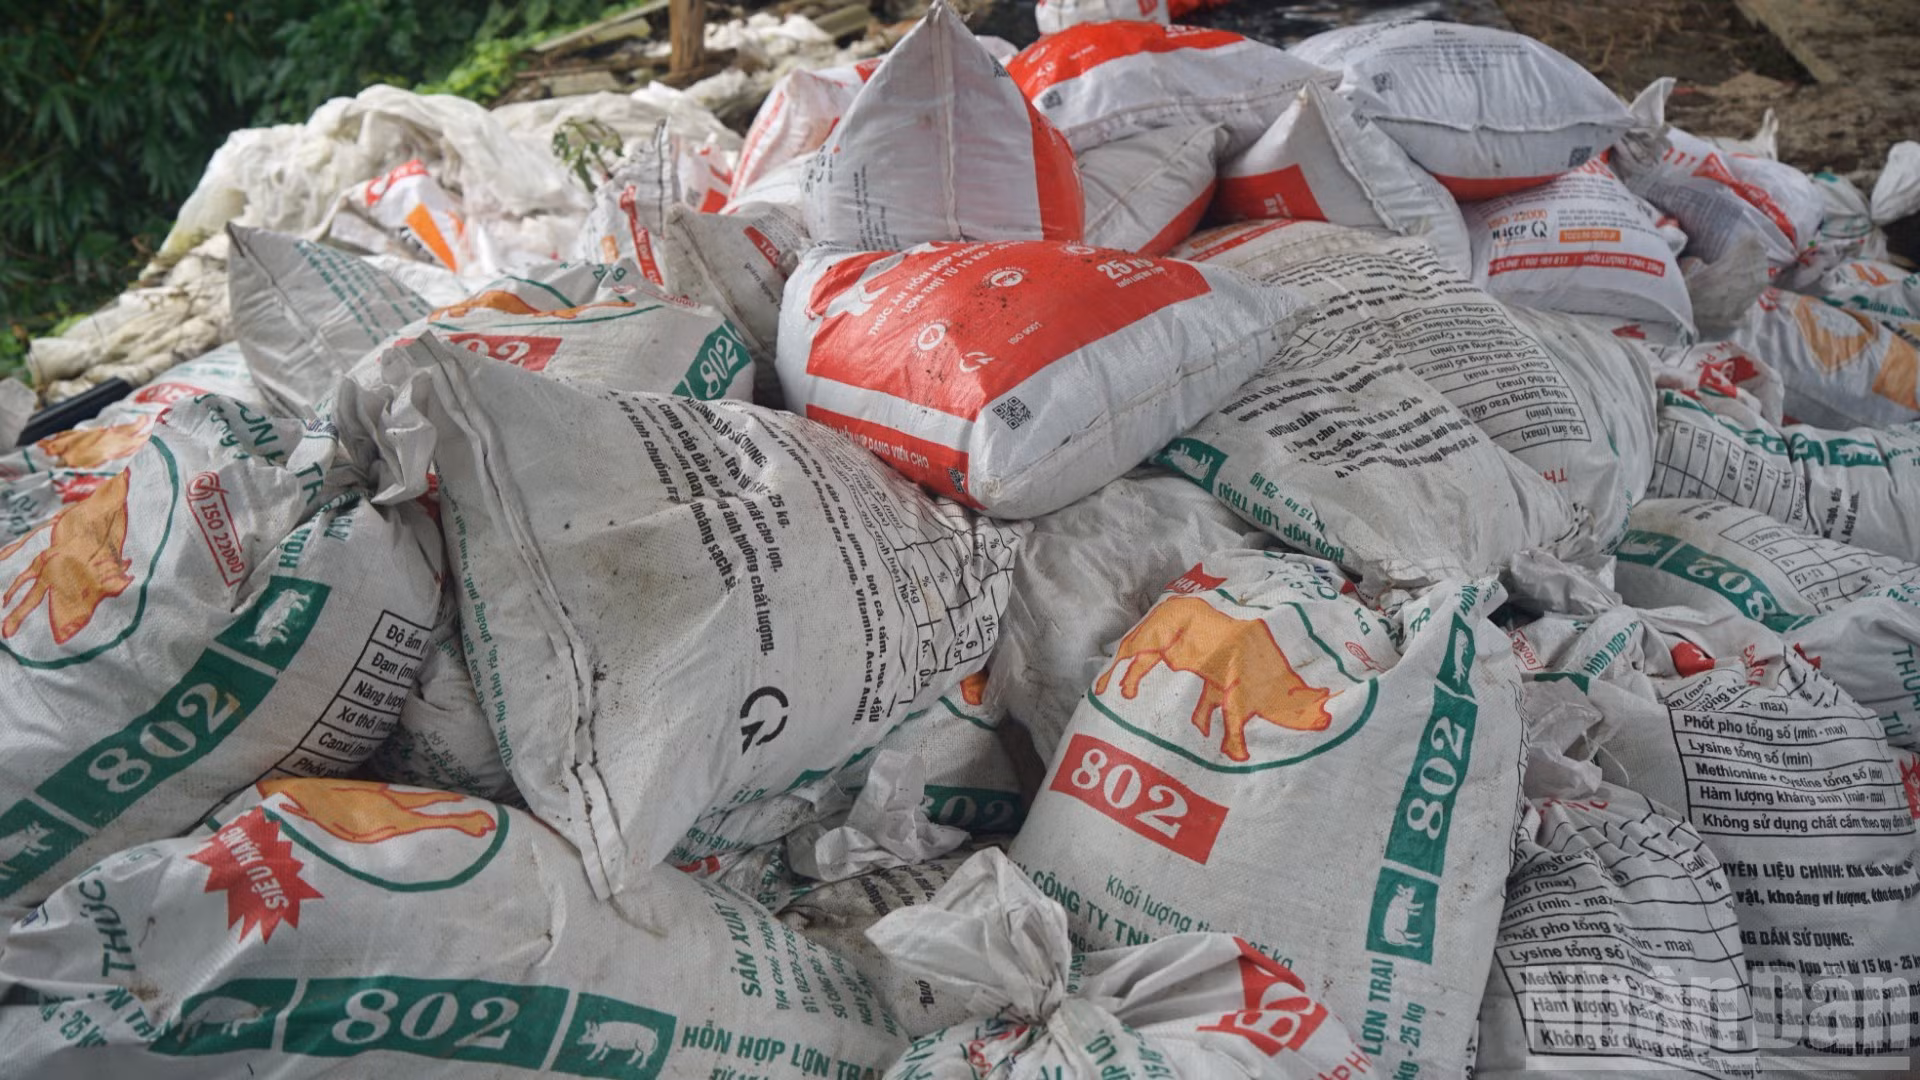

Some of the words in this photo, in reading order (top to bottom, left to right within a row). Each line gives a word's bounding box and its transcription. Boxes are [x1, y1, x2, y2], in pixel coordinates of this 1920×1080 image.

[1096, 259, 1133, 280] 25
[699, 334, 739, 399] 802
[1249, 472, 1267, 492] kg
[1262, 481, 1280, 499] 25
[768, 494, 785, 508] 25
[201, 502, 224, 531] ISO
[755, 522, 776, 544] cho
[1686, 558, 1777, 622] 802
[88, 682, 241, 793] 802
[1683, 714, 1716, 731] Phốt
[1717, 717, 1743, 735] pho
[1746, 719, 1775, 742] tổng
[1777, 724, 1792, 739] số
[1688, 738, 1733, 756] Lysine
[1735, 741, 1762, 764] tổng
[1764, 749, 1780, 765] số
[1782, 752, 1813, 768] (min)
[1405, 715, 1469, 842] 802
[1695, 761, 1768, 782] Methionine
[1779, 774, 1823, 793] Cystine
[1823, 770, 1853, 789] tổng
[1852, 765, 1867, 781] số
[1069, 746, 1191, 842] 802
[1700, 785, 1733, 802] Hàm
[1735, 789, 1775, 806] lượng
[1777, 791, 1817, 806] kháng
[1702, 813, 1750, 834] Không
[1752, 812, 1772, 831] sử
[1773, 816, 1809, 833] dụng
[1811, 812, 1838, 831] chất
[1839, 812, 1861, 830] cấm
[1763, 864, 1796, 881] LIỆU
[1799, 860, 1845, 879] CHÍNH:
[246, 865, 290, 911] SIÊU
[1536, 876, 1577, 894] (max)
[1032, 869, 1081, 915] CÔNG
[1086, 900, 1110, 934] TY
[1104, 874, 1142, 909] Khối
[1142, 894, 1194, 934] lượng
[1538, 897, 1571, 914] (min
[1767, 889, 1820, 907] khoáng
[1822, 890, 1835, 905] vi
[1541, 920, 1572, 937] pho
[1571, 917, 1611, 934] tổng
[1759, 927, 1791, 946] DẪN
[1792, 926, 1813, 946] SỬ
[1814, 931, 1855, 950] DỤNG:
[1512, 945, 1563, 962] Lysine
[1565, 940, 1603, 961] tổng
[1606, 943, 1626, 960] số
[730, 950, 763, 998] SẢN
[1862, 959, 1877, 974] 15
[1877, 958, 1893, 974] kg
[1900, 955, 1913, 970] 25
[1367, 957, 1398, 1002] TRẠI
[332, 985, 520, 1051] 802
[1402, 1002, 1427, 1025] kg
[1362, 1008, 1391, 1057] LỢN
[1400, 1024, 1422, 1049] 25
[1541, 1029, 1597, 1051] Không
[682, 1019, 732, 1054] HỖN
[737, 1035, 786, 1066] HỢP
[790, 1042, 832, 1078] LỢN
